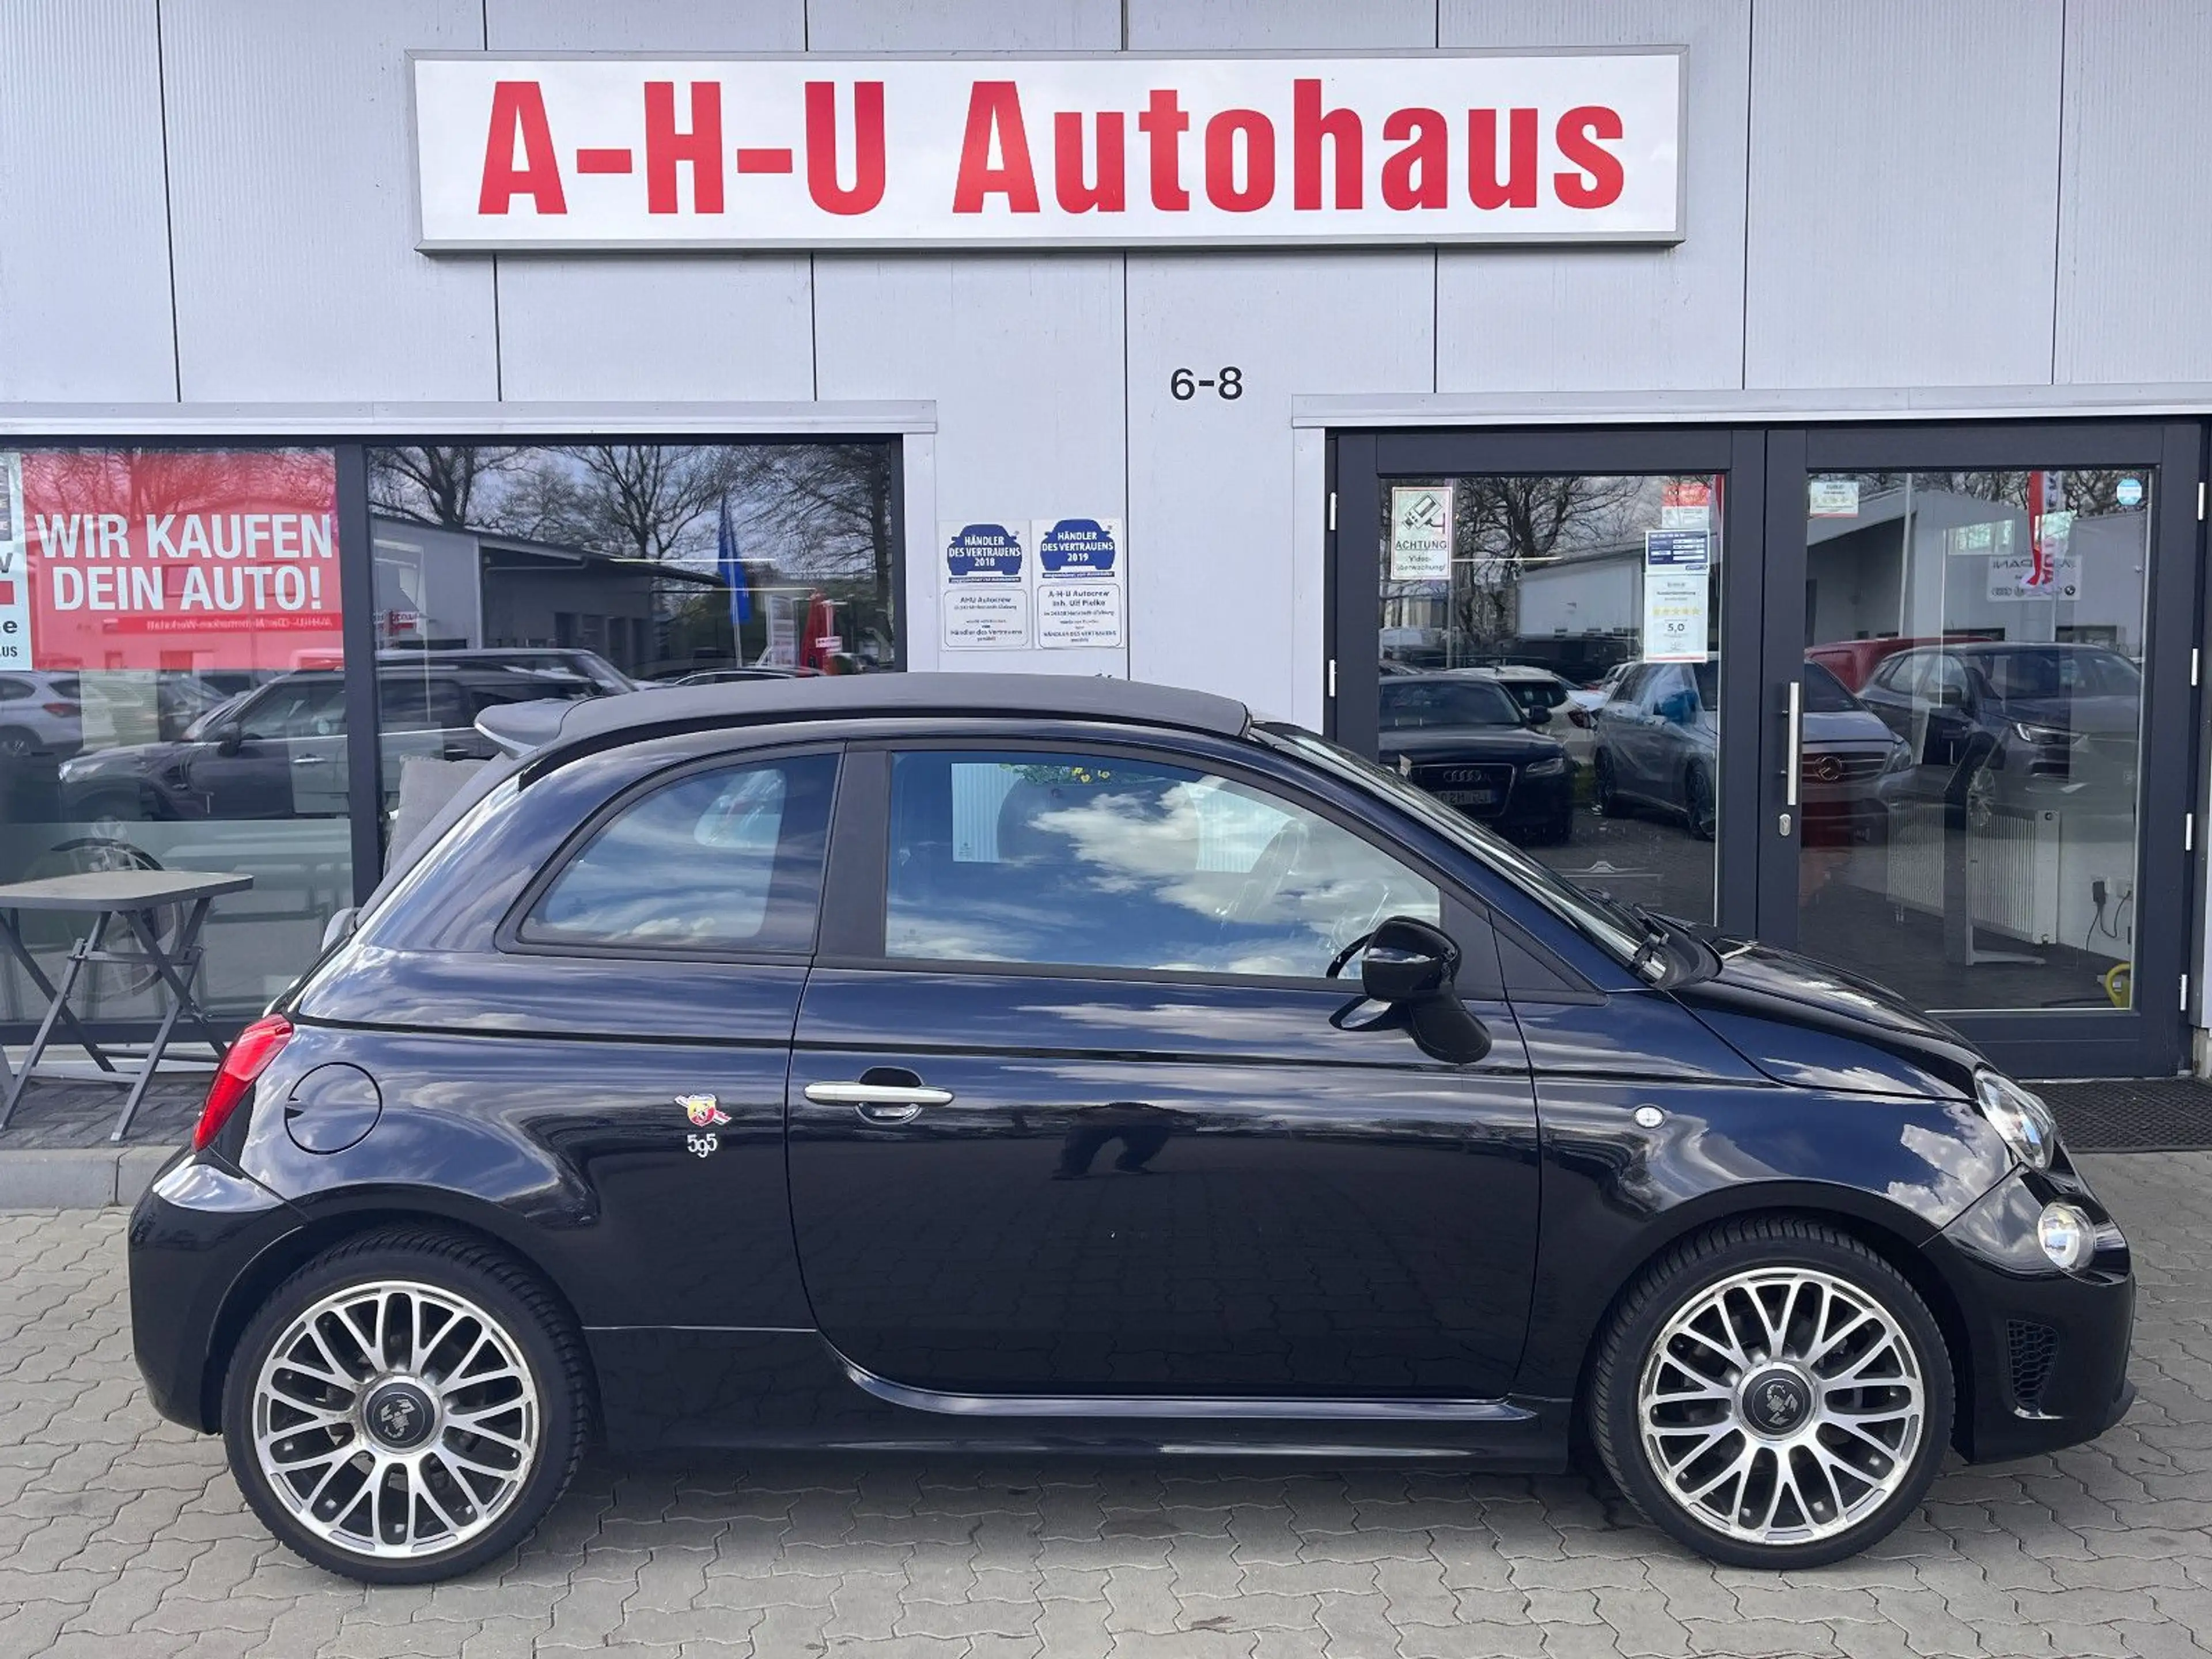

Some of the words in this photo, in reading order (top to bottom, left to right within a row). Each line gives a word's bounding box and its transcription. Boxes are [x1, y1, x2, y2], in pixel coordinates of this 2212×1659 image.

[479, 81, 885, 216] A-H-U
[953, 79, 1624, 213] Autohaus
[1171, 366, 1243, 400] 6-8
[35, 514, 130, 558] WIR
[146, 514, 332, 558] KAUFEN
[964, 535, 1005, 546] HÄNDLER
[1057, 531, 1097, 540] HÄNDLER
[1041, 543, 1058, 551] DES
[1059, 542, 1114, 551] VERTRAUENS
[1396, 540, 1447, 549] ACHTUNG
[948, 548, 964, 558] DES
[965, 547, 1021, 557] VERTRAUENS
[1067, 553, 1089, 562] 2019
[974, 557, 995, 566] 2018
[52, 566, 164, 610] DEIN
[180, 565, 322, 611] AUTO!
[1668, 623, 1685, 633] 5,0
[687, 1133, 718, 1158] 595
